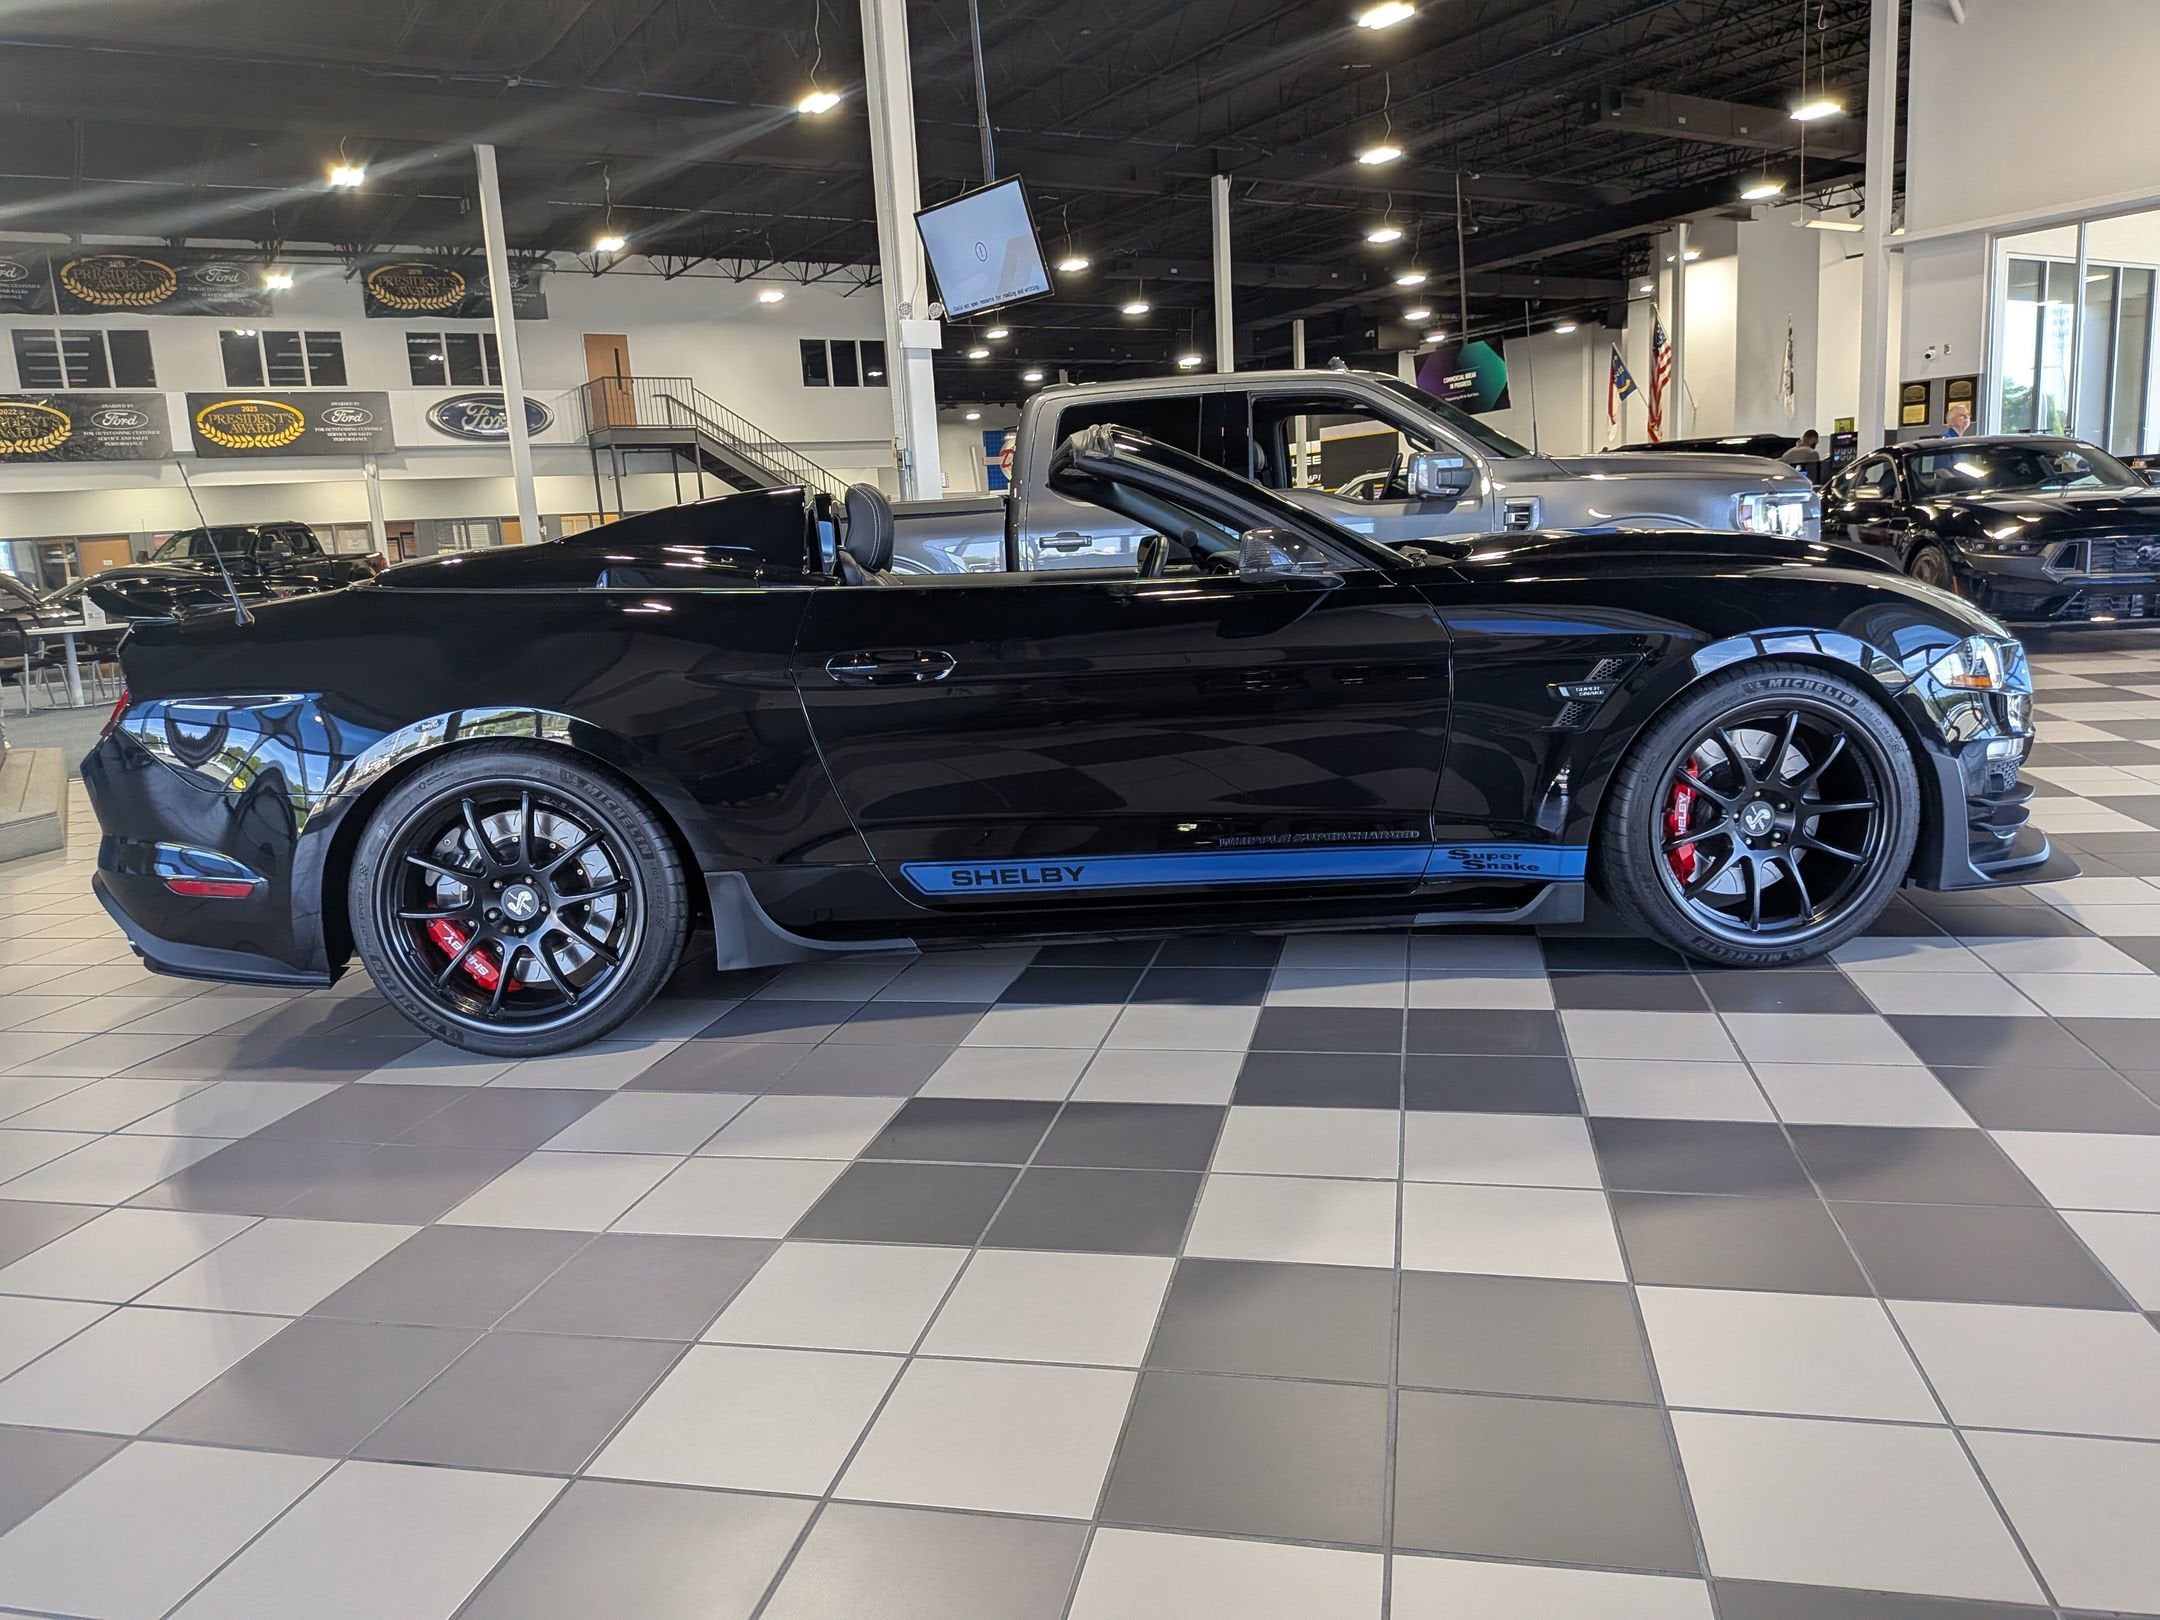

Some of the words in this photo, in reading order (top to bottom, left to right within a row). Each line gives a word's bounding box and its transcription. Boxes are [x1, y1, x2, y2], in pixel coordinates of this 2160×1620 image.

[206, 268, 240, 282] Ford
[102, 412, 138, 426] Ford
[208, 413, 295, 424] PRESIDENT'S
[331, 409, 364, 422] Ford
[229, 423, 276, 434] AWARD
[1768, 678, 1855, 705] MICHELIN
[583, 782, 653, 857] MICHELIN
[1678, 791, 1688, 834] HELBY
[1293, 830, 1420, 843] SUPERCHARGED
[1447, 848, 1522, 861] Super
[1462, 859, 1540, 872] Snake
[951, 865, 1086, 887] SHELBY
[1696, 939, 1782, 962] MICHELIN
[373, 959, 441, 1030] MICHELIN
